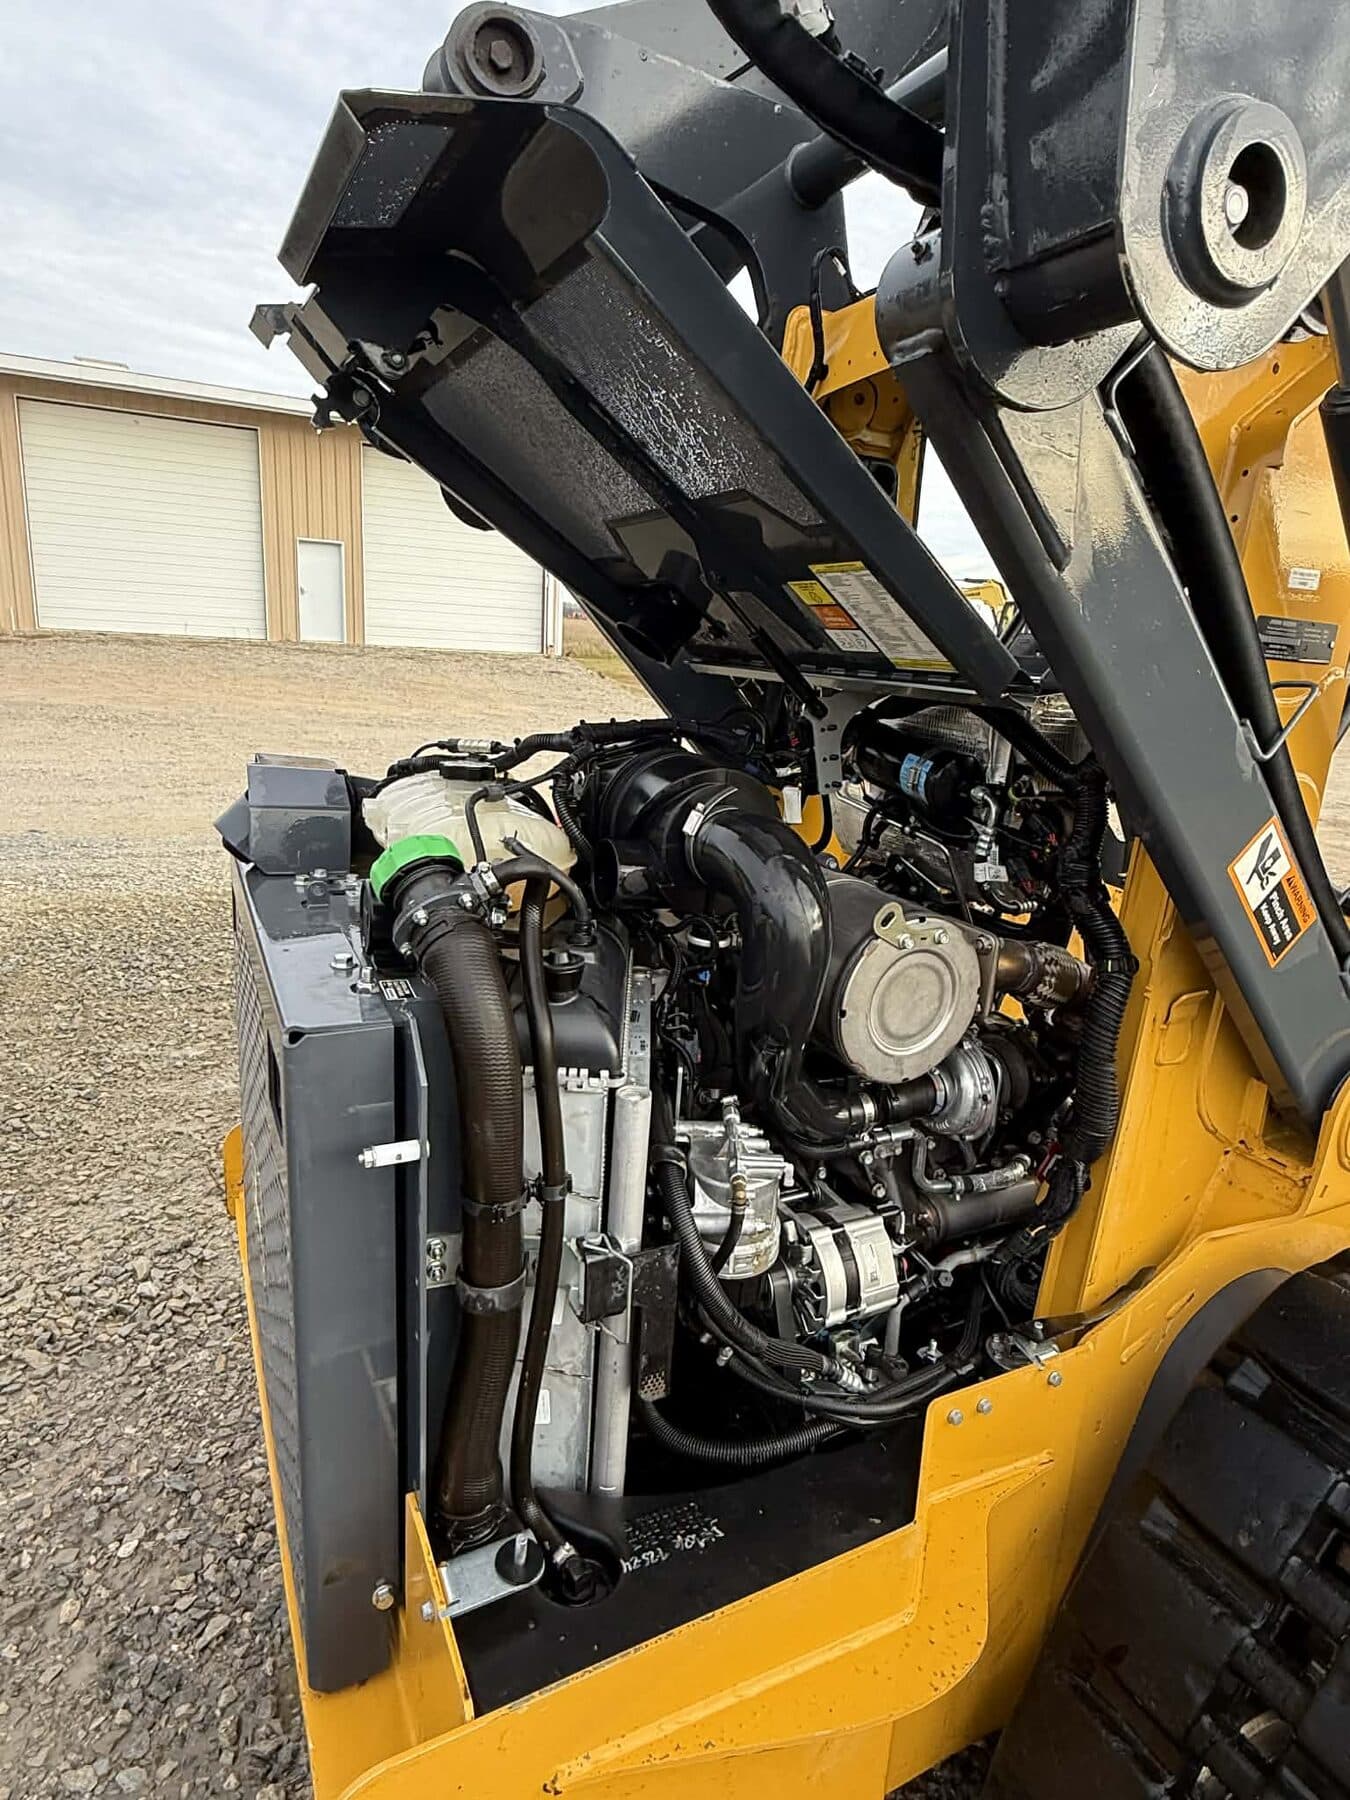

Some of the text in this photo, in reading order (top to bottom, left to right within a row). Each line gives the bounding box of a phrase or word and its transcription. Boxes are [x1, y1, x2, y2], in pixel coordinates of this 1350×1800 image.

[1269, 891, 1293, 941] Pinch Area
[1291, 883, 1311, 923] WARNING
